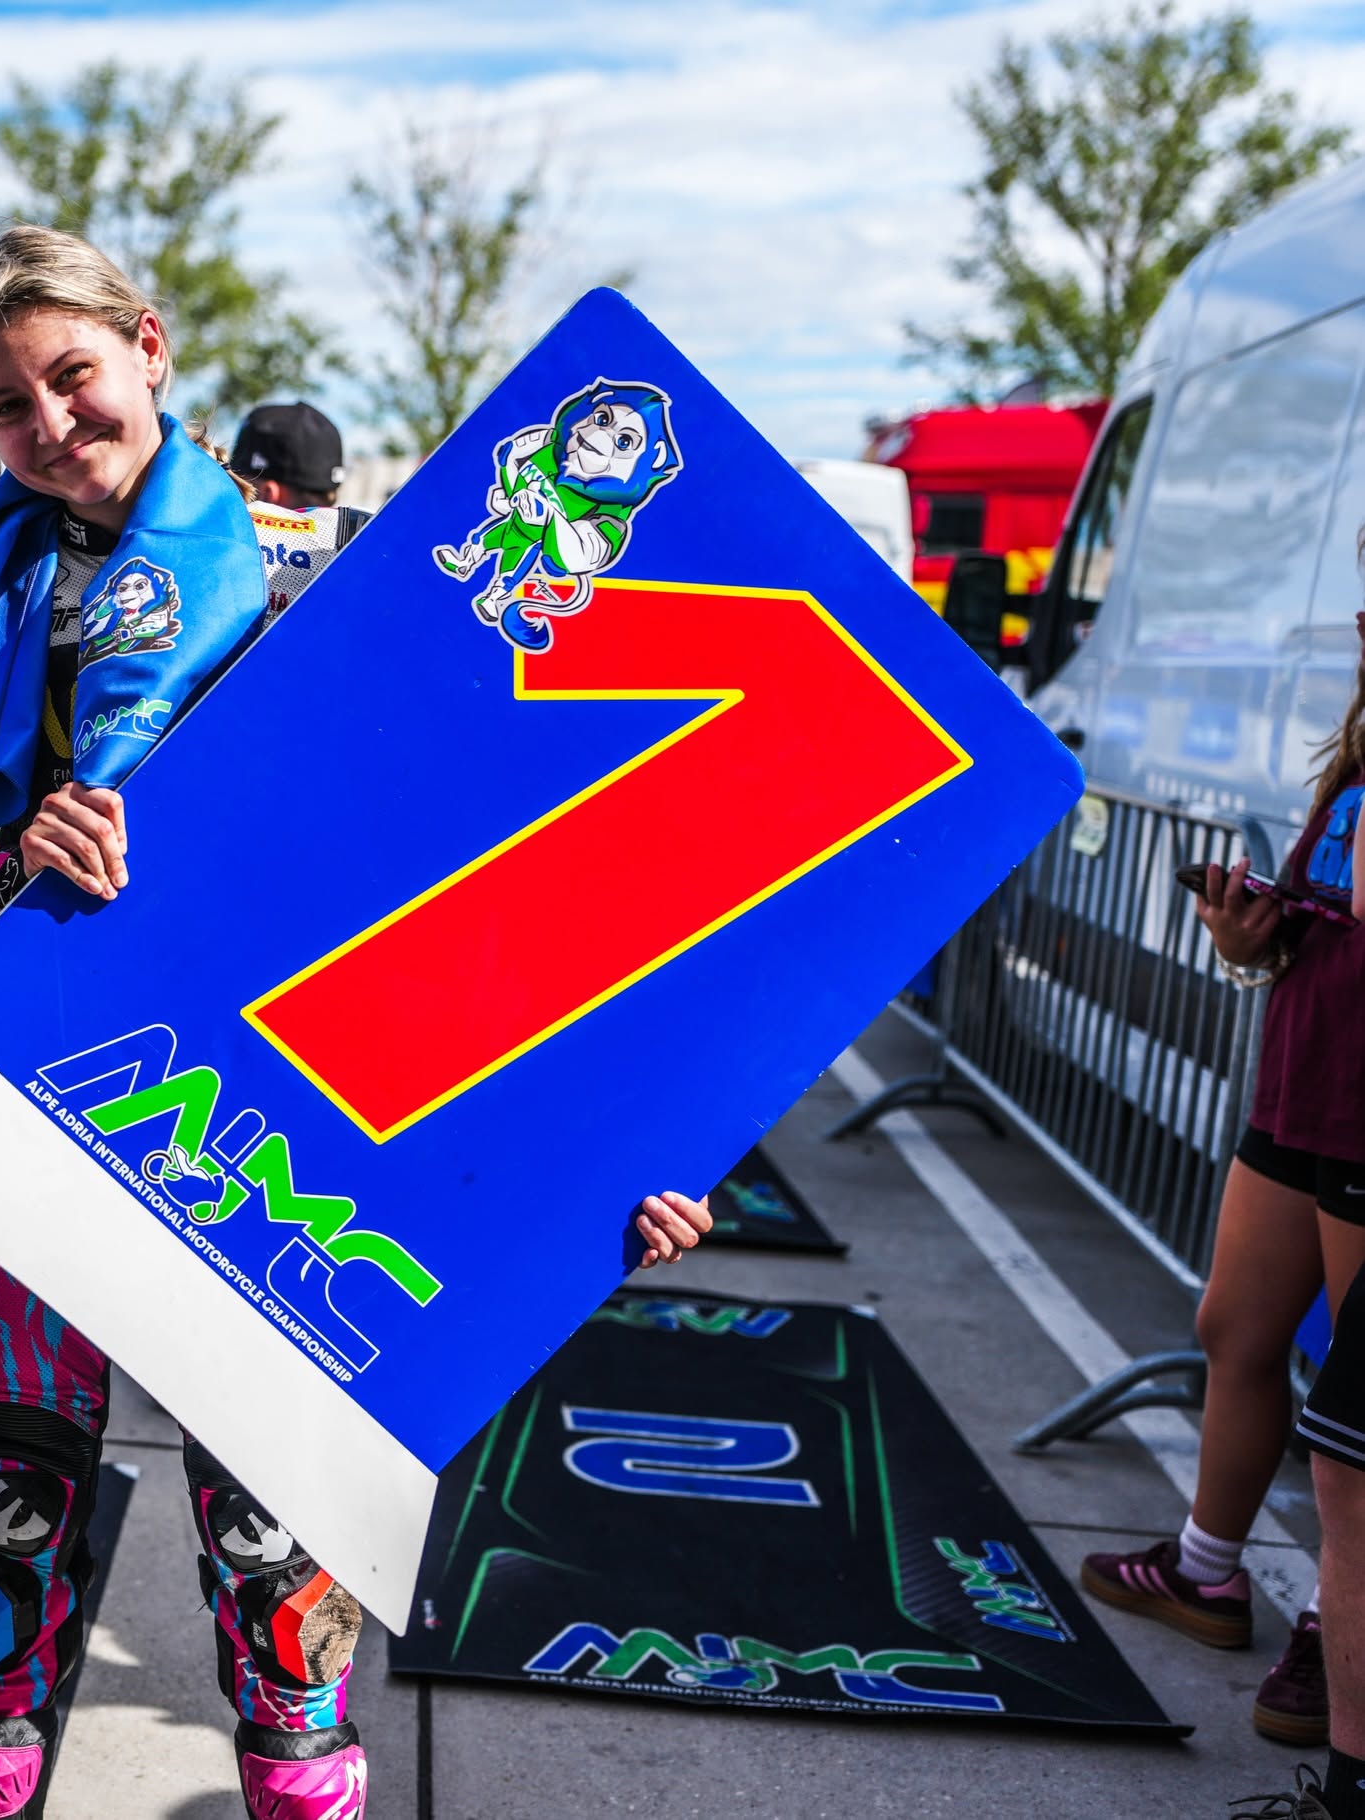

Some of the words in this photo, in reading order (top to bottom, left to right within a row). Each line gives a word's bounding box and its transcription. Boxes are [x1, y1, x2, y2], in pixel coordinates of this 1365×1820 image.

[240, 572, 975, 1145] 1
[25, 1080, 59, 1112] ALPE
[55, 1107, 93, 1147] ADRIA
[93, 1140, 185, 1231] INTERNATIONAL
[182, 1225, 265, 1304] MOTORCYCLE
[262, 1298, 354, 1384] CHAMPIONSHIP
